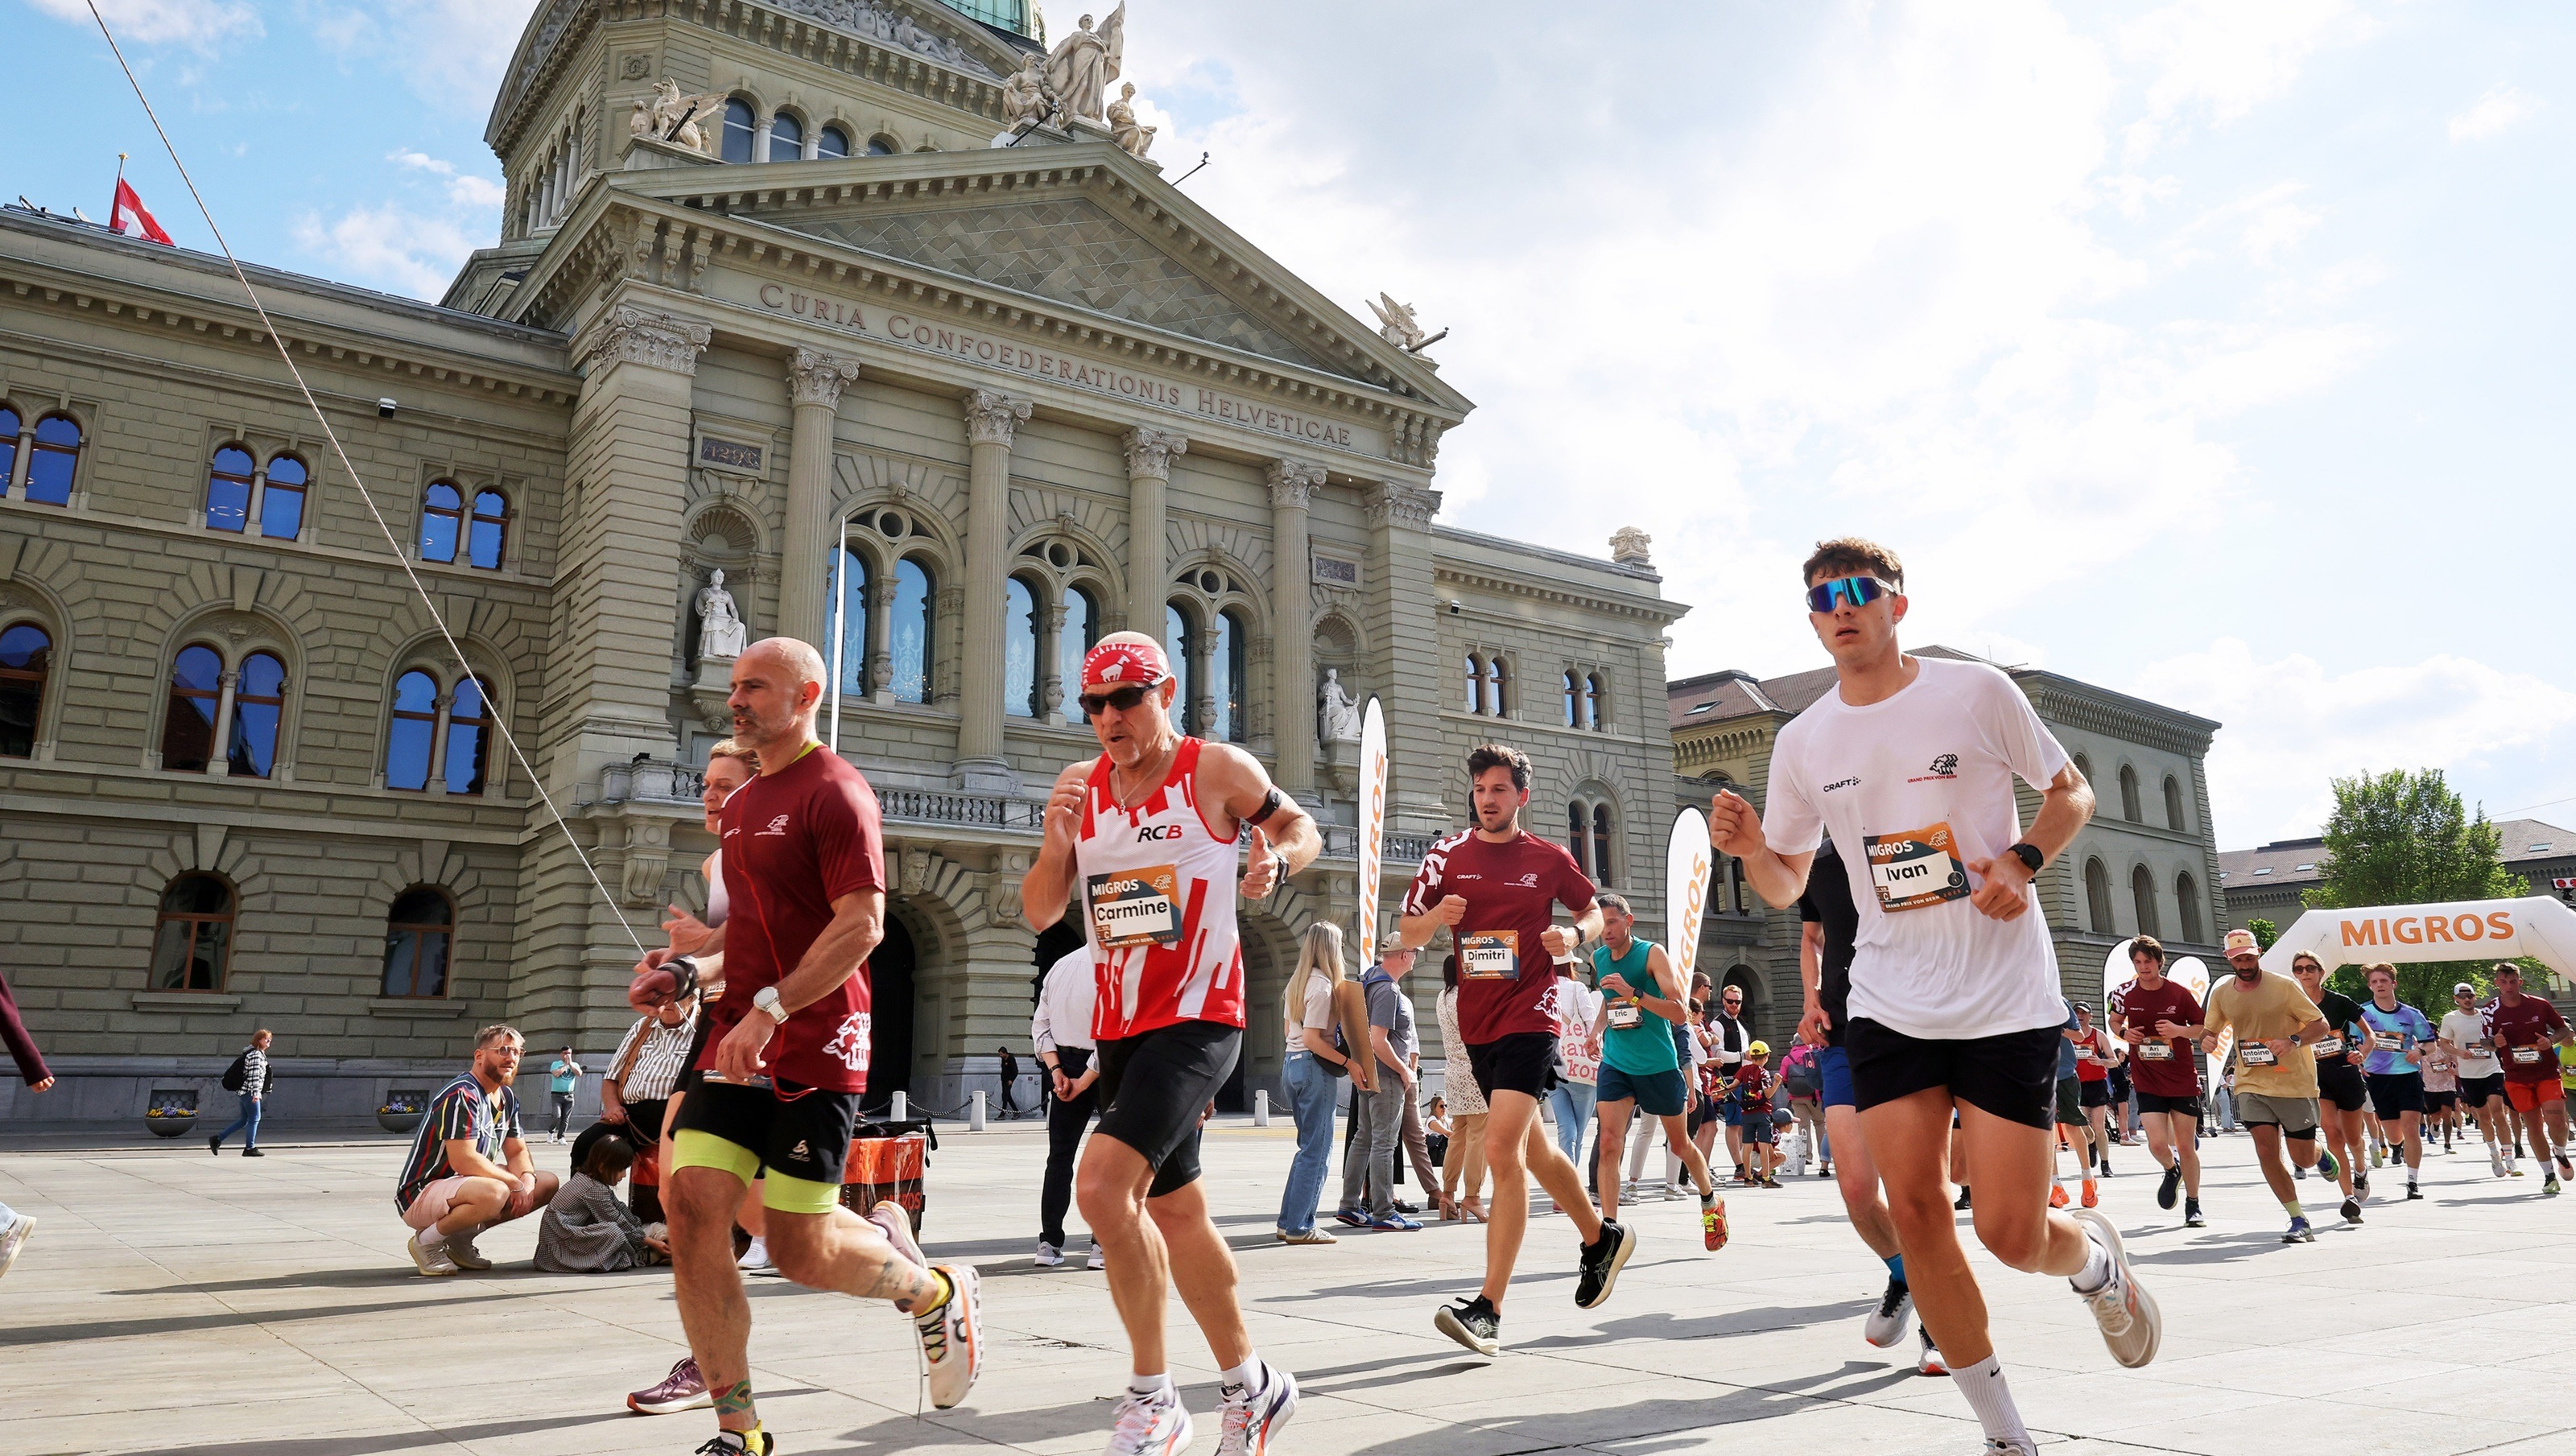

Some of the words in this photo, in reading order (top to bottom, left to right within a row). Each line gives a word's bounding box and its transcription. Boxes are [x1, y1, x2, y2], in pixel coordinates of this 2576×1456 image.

[760, 283, 866, 330] CURIA
[888, 315, 1180, 405] CONFOEDERATIONIS
[1198, 389, 1352, 447] HELVETICAE
[1823, 778, 1852, 793] CRAFT
[1137, 825, 1183, 843] RCB
[1867, 839, 1913, 857] MIGROS
[1362, 749, 1385, 967] MIGROS
[1885, 864, 1929, 881] Ivan
[1092, 879, 1139, 897] MIGROS
[1096, 900, 1167, 922] Carmine
[2340, 912, 2514, 947] MIGROS
[1461, 936, 1494, 945] MIGROS
[1468, 950, 1505, 960] Dimitri
